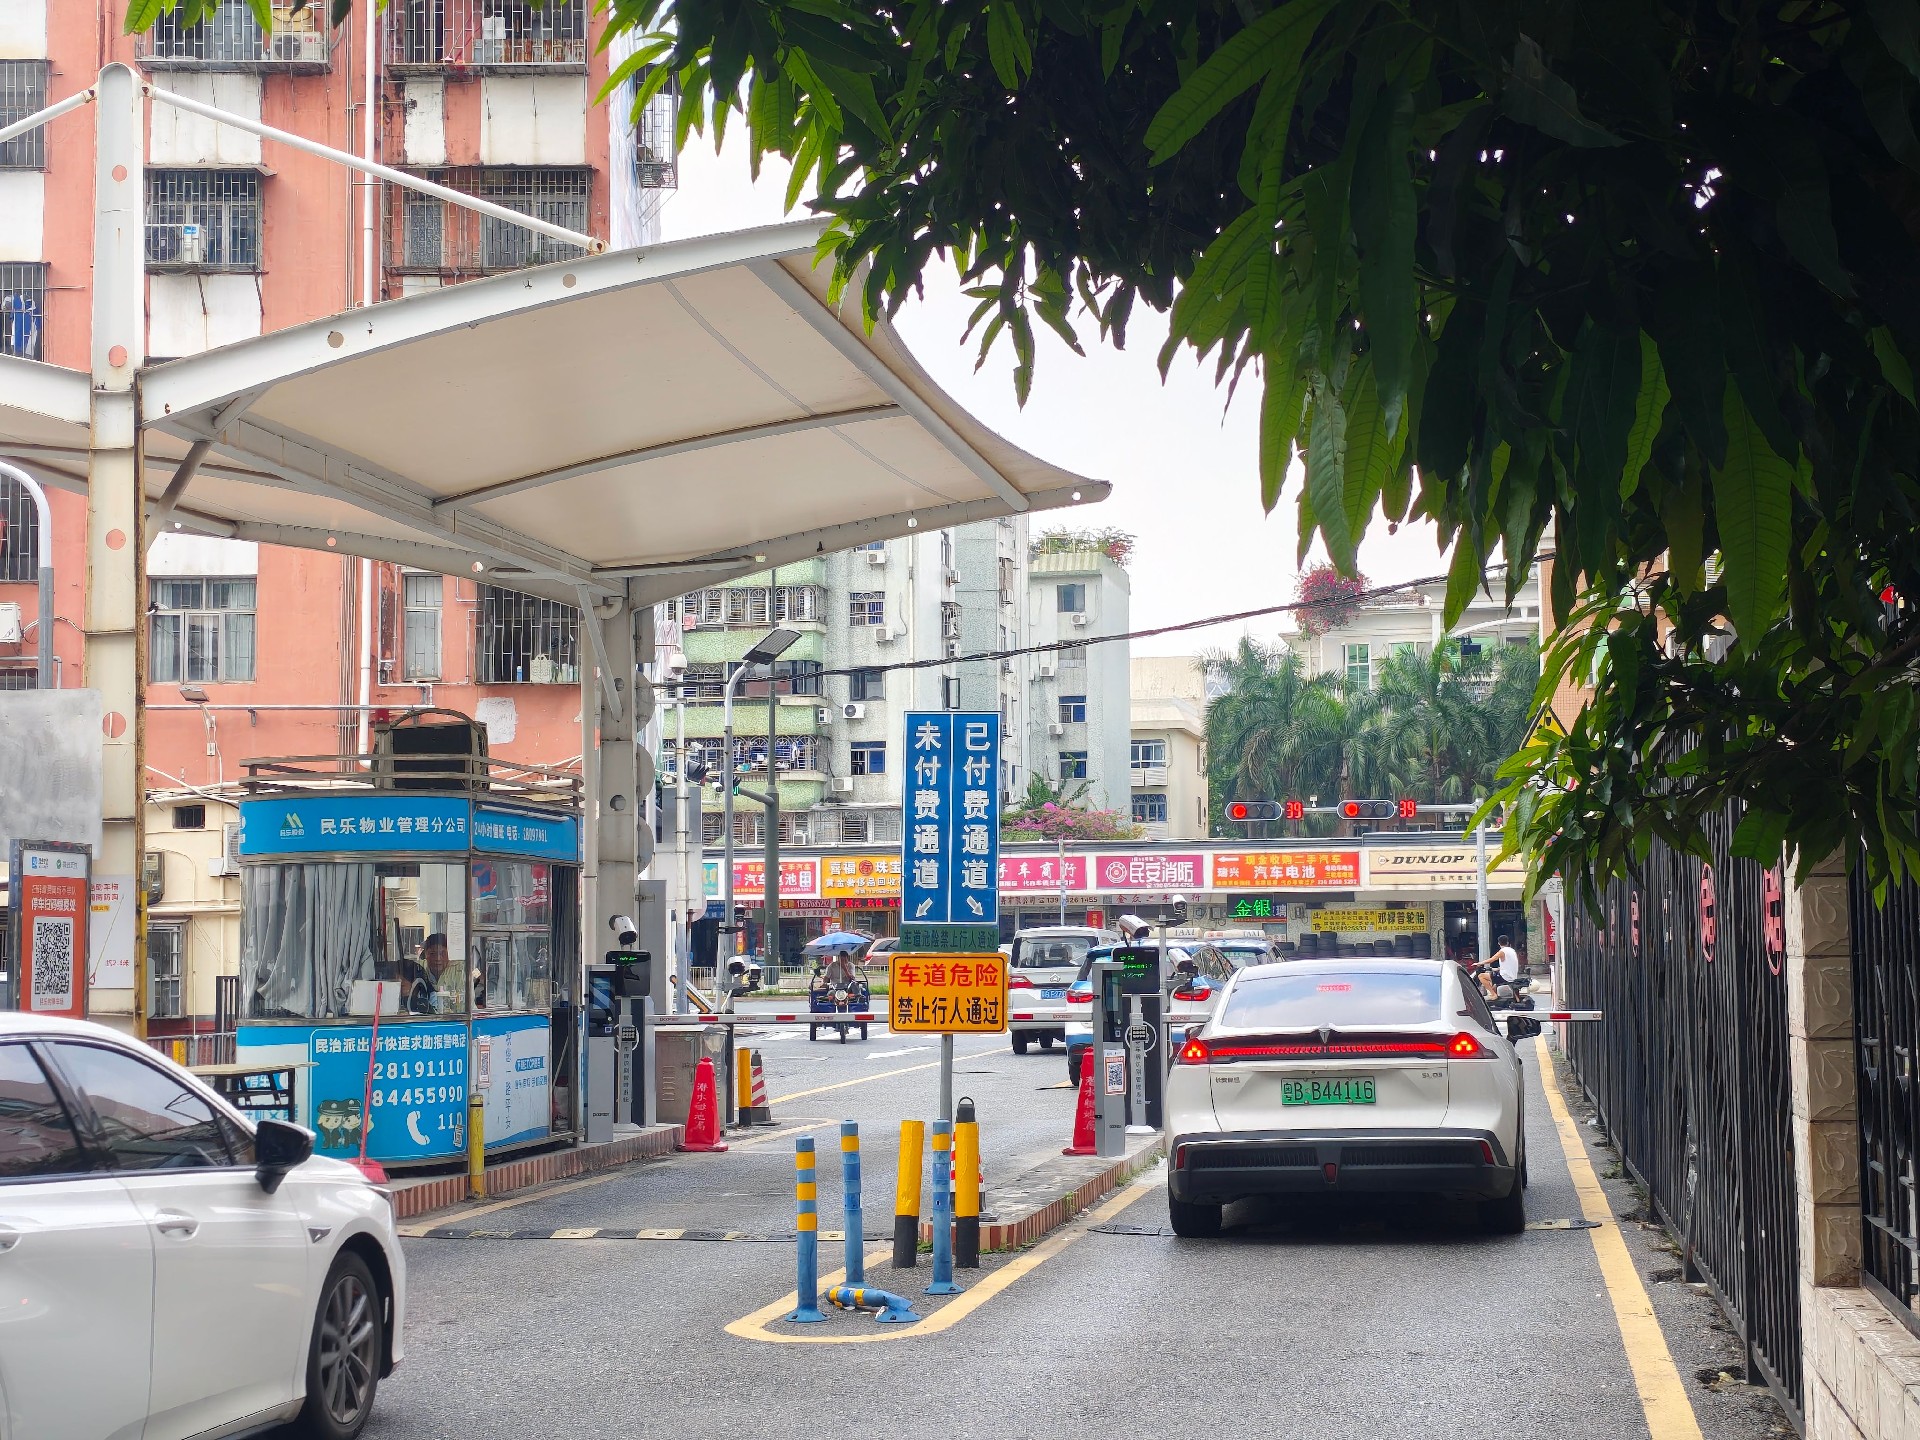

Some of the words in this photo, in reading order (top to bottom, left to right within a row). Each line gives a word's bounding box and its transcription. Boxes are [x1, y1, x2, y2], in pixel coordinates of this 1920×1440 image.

[913, 720, 942, 889] 未付费通道
[961, 722, 991, 889] 已付费通道
[1287, 802, 1302, 819] 39
[1400, 801, 1414, 817] 39
[320, 816, 466, 835] 民乐物业管理分公司
[748, 863, 812, 872] 现金二手汽车
[830, 861, 856, 875] 喜福
[1245, 854, 1342, 865] 现金收购二手汽车
[1391, 855, 1465, 864] DUNLOP
[1129, 861, 1194, 883] 民安消防
[1253, 865, 1316, 880] 汽车电池
[826, 877, 901, 887] 黄金奢侈品回收
[1235, 899, 1271, 917] 金银
[903, 930, 996, 948] 车道危险禁止行人通过
[898, 963, 999, 987] 车道危险
[898, 996, 999, 1025] 禁止行人通过
[373, 1059, 463, 1080] 28191110
[372, 1085, 463, 1107] 84455990
[437, 1112, 463, 1131] 110
